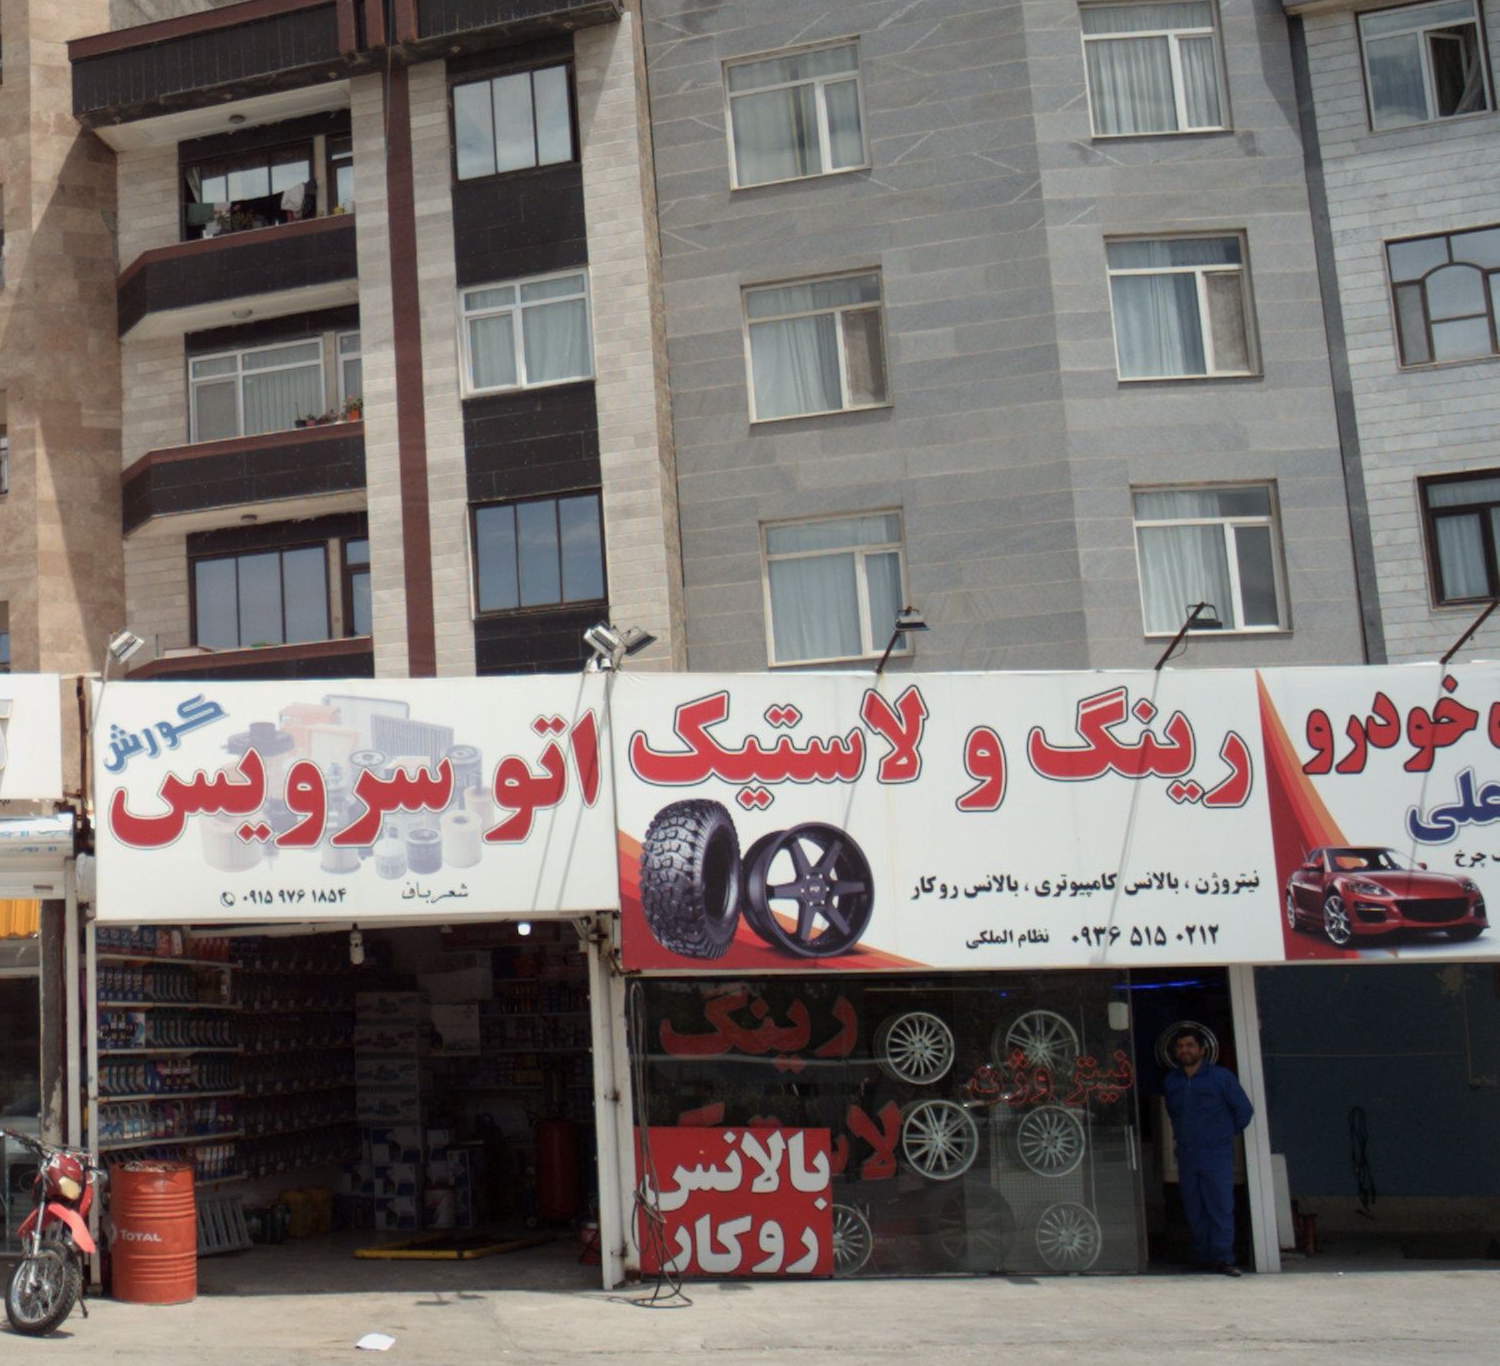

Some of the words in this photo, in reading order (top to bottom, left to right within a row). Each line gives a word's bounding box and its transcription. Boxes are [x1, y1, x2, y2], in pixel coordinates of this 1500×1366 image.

[103, 693, 228, 775] کورش
[628, 684, 930, 811] لاستیک
[1027, 685, 1254, 809] رینگ
[1302, 674, 1479, 774] خودرو
[108, 746, 456, 851] سرویس
[482, 708, 602, 845] اتو
[956, 725, 1008, 812] و
[964, 874, 1019, 898] بالانس
[1035, 873, 1118, 898] کامپیوتری
[1124, 871, 1180, 896] بالانس
[1018, 928, 1050, 948] نظام
[1071, 926, 1121, 947] ۰۹۳۶
[1130, 925, 1167, 946] ۵۱۵
[659, 982, 859, 1074] رینگ
[640, 1130, 831, 1211] بالانس
[659, 1213, 819, 1274] روکار
